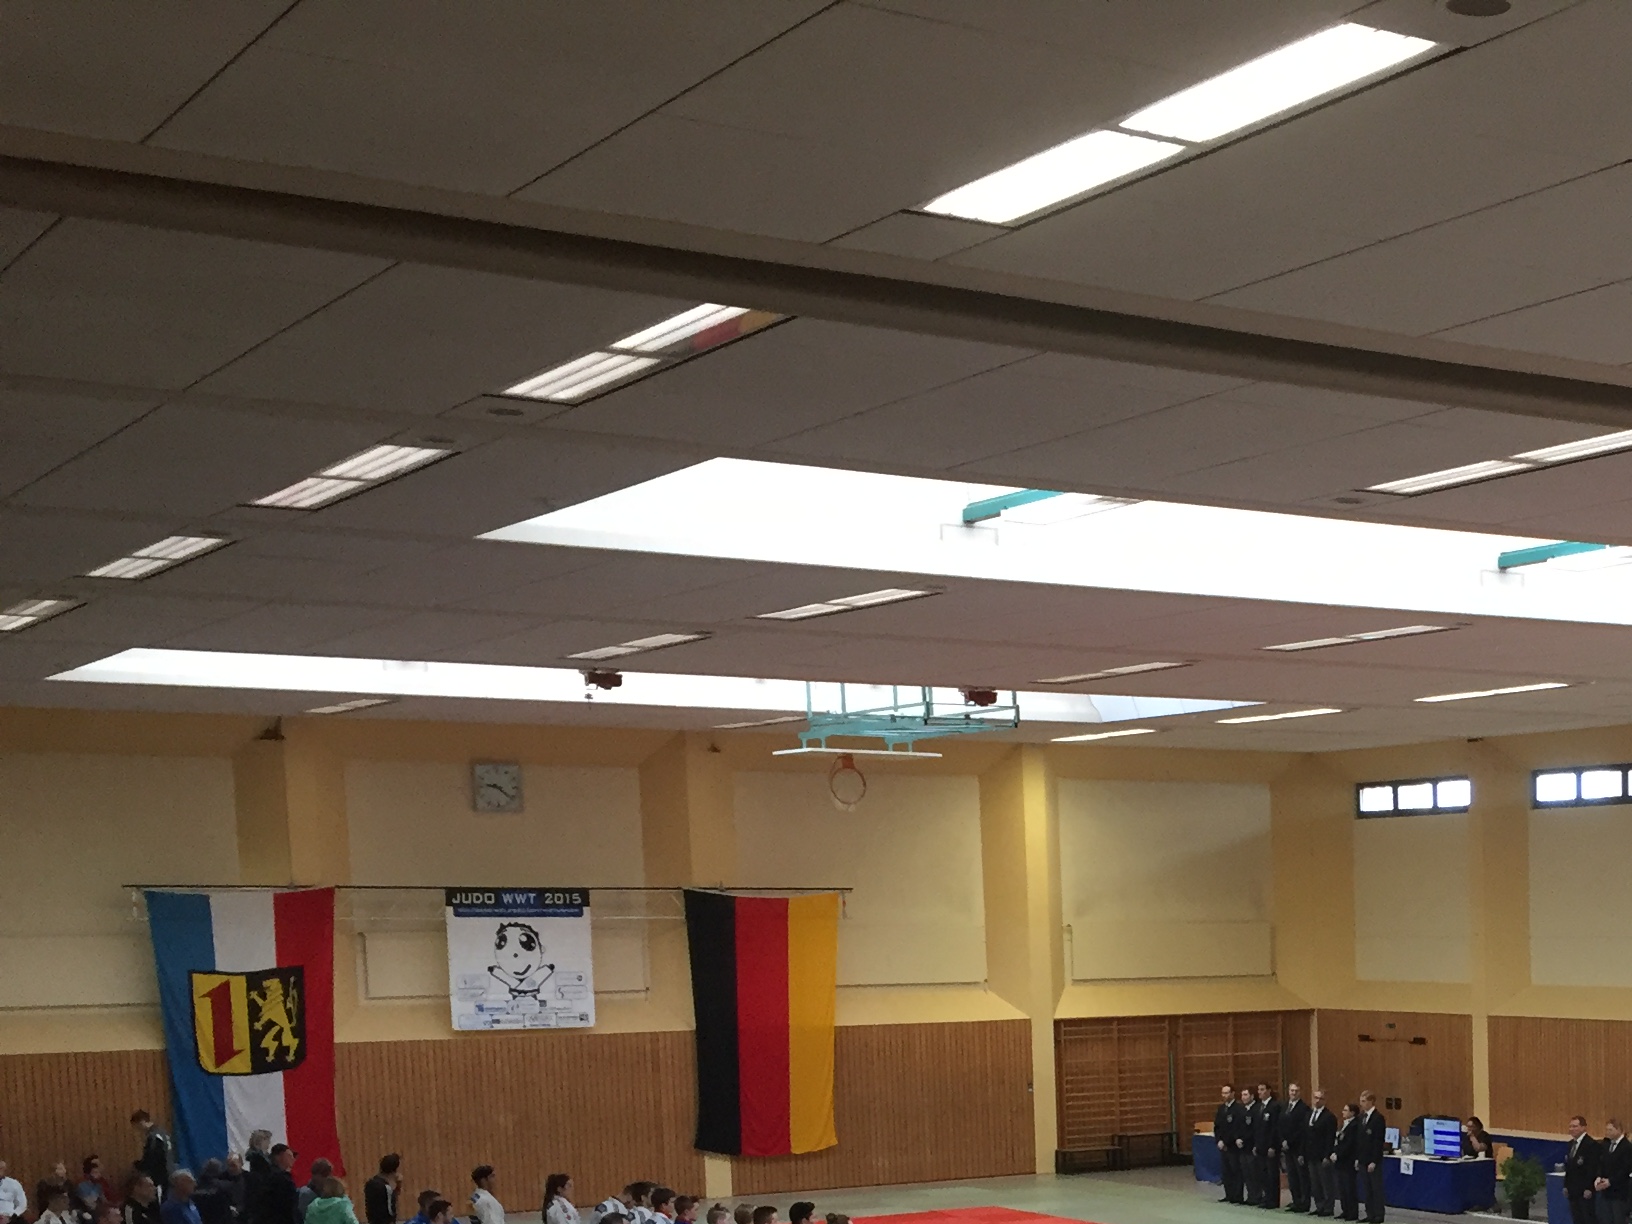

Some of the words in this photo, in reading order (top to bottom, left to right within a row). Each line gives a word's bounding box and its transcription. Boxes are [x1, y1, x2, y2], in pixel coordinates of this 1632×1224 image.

[452, 892, 496, 905] JUDO
[501, 892, 537, 905] WWT
[544, 892, 582, 905] 2015
